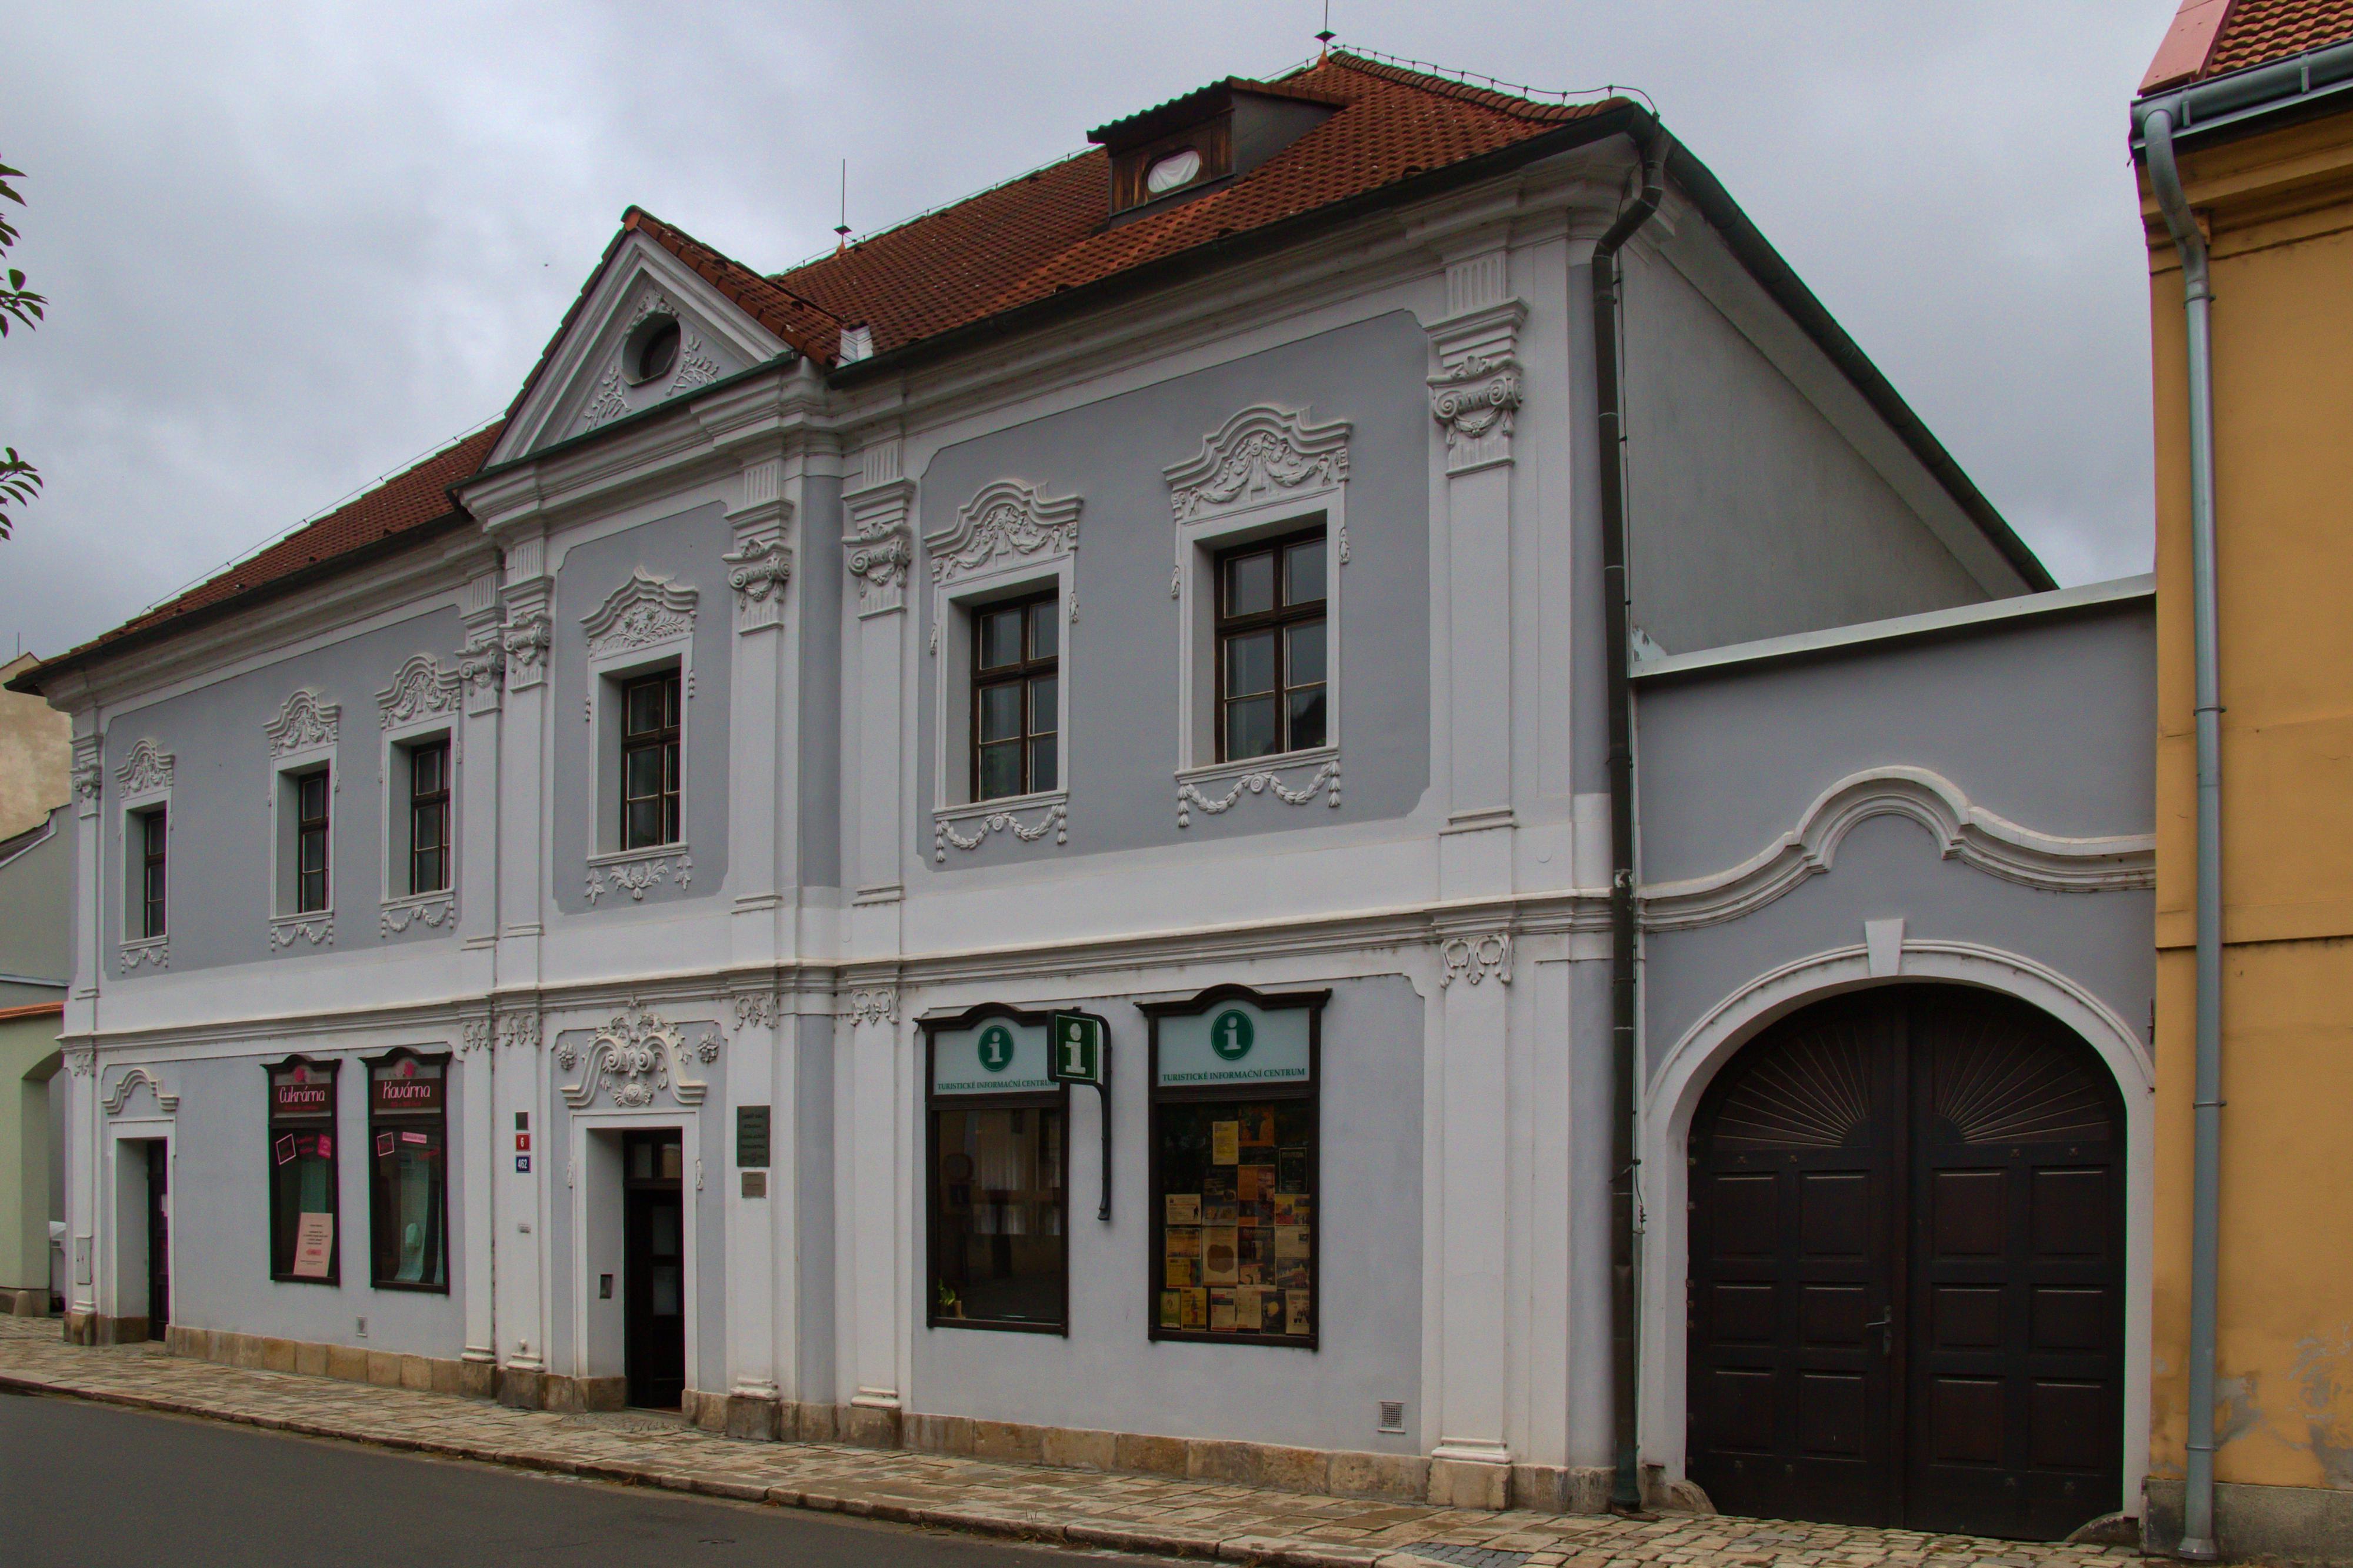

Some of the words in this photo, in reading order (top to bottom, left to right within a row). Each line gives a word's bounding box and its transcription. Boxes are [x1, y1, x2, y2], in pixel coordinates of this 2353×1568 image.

[1162, 1072, 1208, 1082] TURISTICKÉ
[1209, 1068, 1262, 1079] INFORMAČNÍ
[1264, 1068, 1305, 1077] CENTRUM
[383, 1082, 431, 1099] Kavárna
[938, 1082, 975, 1090] TURISTICKÉ
[977, 1079, 1021, 1088] INFORMAČNÍ
[279, 1086, 325, 1103] Cukrárna
[520, 1137, 525, 1147] 6
[518, 1159, 528, 1169] 462
